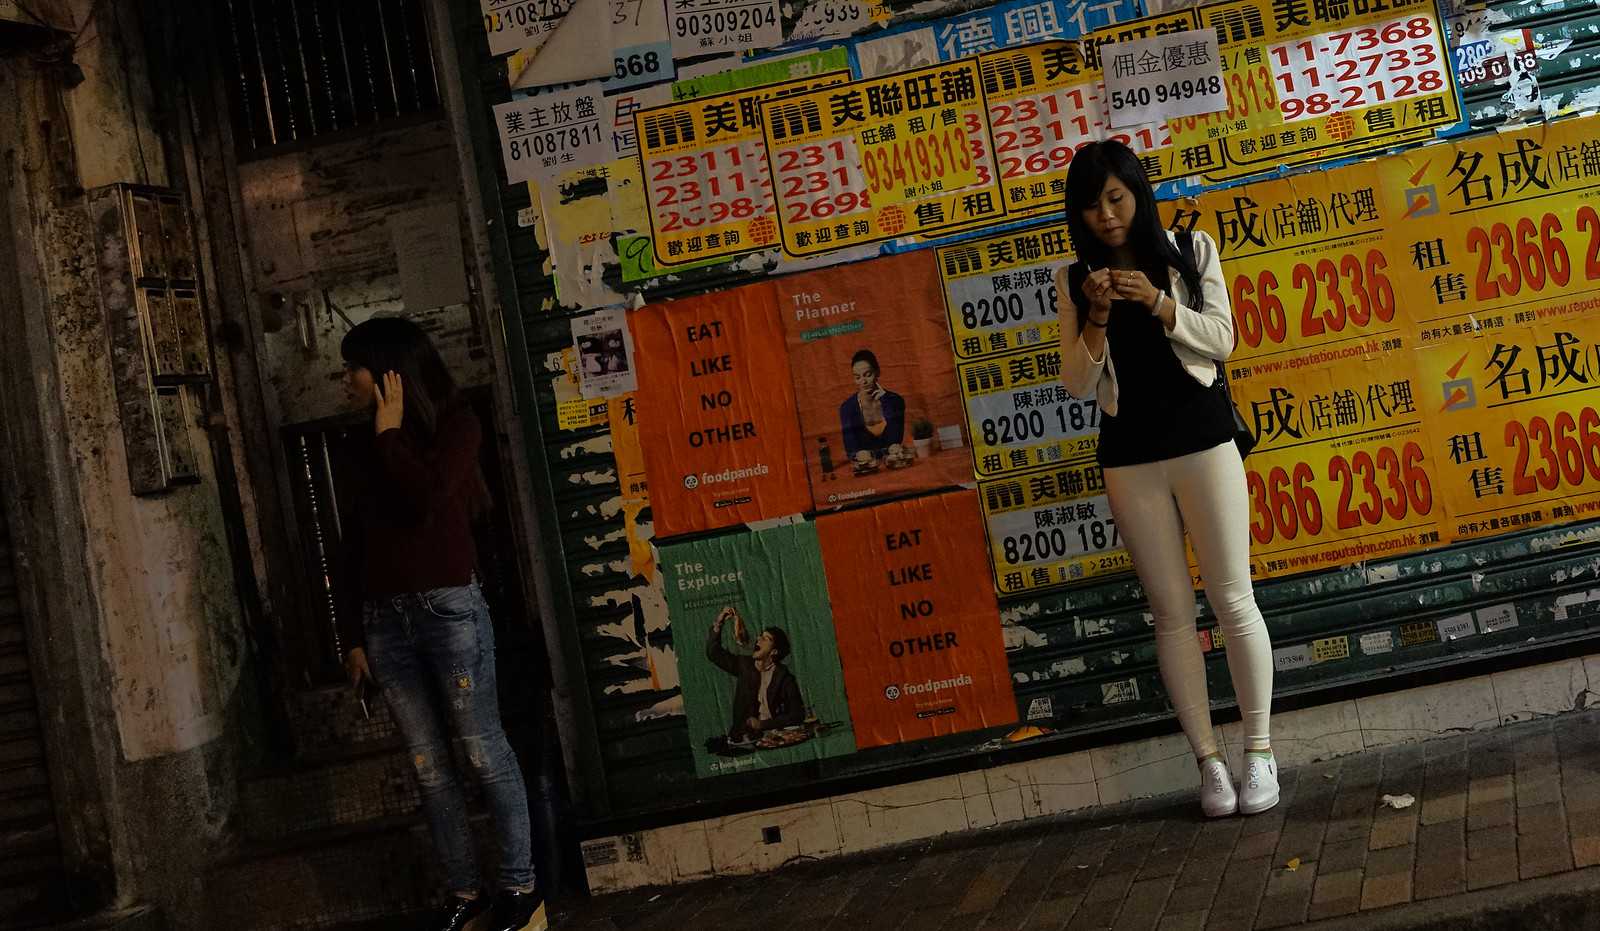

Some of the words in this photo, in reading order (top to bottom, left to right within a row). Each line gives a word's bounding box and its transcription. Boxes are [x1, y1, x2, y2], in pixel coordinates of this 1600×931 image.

[676, 6, 776, 38] 90309204
[1271, 18, 1433, 67] 11-7368
[1111, 40, 1212, 79] 佣金優惠
[1277, 44, 1437, 93] 11-2733
[829, 66, 977, 128] 美聯旺舖
[1112, 87, 1151, 111] 540
[1154, 75, 1222, 104] 94948
[1280, 70, 1444, 121] 98-2128
[505, 95, 596, 134] 業主放盤
[510, 122, 602, 162] 81087811
[863, 127, 971, 195] 93419313
[1465, 213, 1571, 302] 2366
[991, 266, 1055, 294] 陳淑敏
[1292, 248, 1396, 337] 2336
[792, 290, 822, 308] The
[795, 300, 857, 321] Planner
[961, 292, 1024, 330] 8200
[686, 321, 722, 343] EAT
[691, 354, 733, 377] LIKE
[701, 390, 733, 411] NO
[689, 422, 757, 448] OTHER
[982, 409, 1045, 446] 8200
[702, 462, 769, 486] foodpanda
[1327, 440, 1433, 530] 2336
[1034, 501, 1097, 529] 陳淑敏
[885, 528, 922, 552] EAT
[1003, 527, 1066, 565] 8200
[674, 561, 704, 577] The
[677, 570, 744, 592] Explorer
[889, 563, 933, 587] LIKE
[900, 599, 934, 621] NO
[889, 631, 959, 659] OTHER
[902, 673, 973, 697] foodpanda
